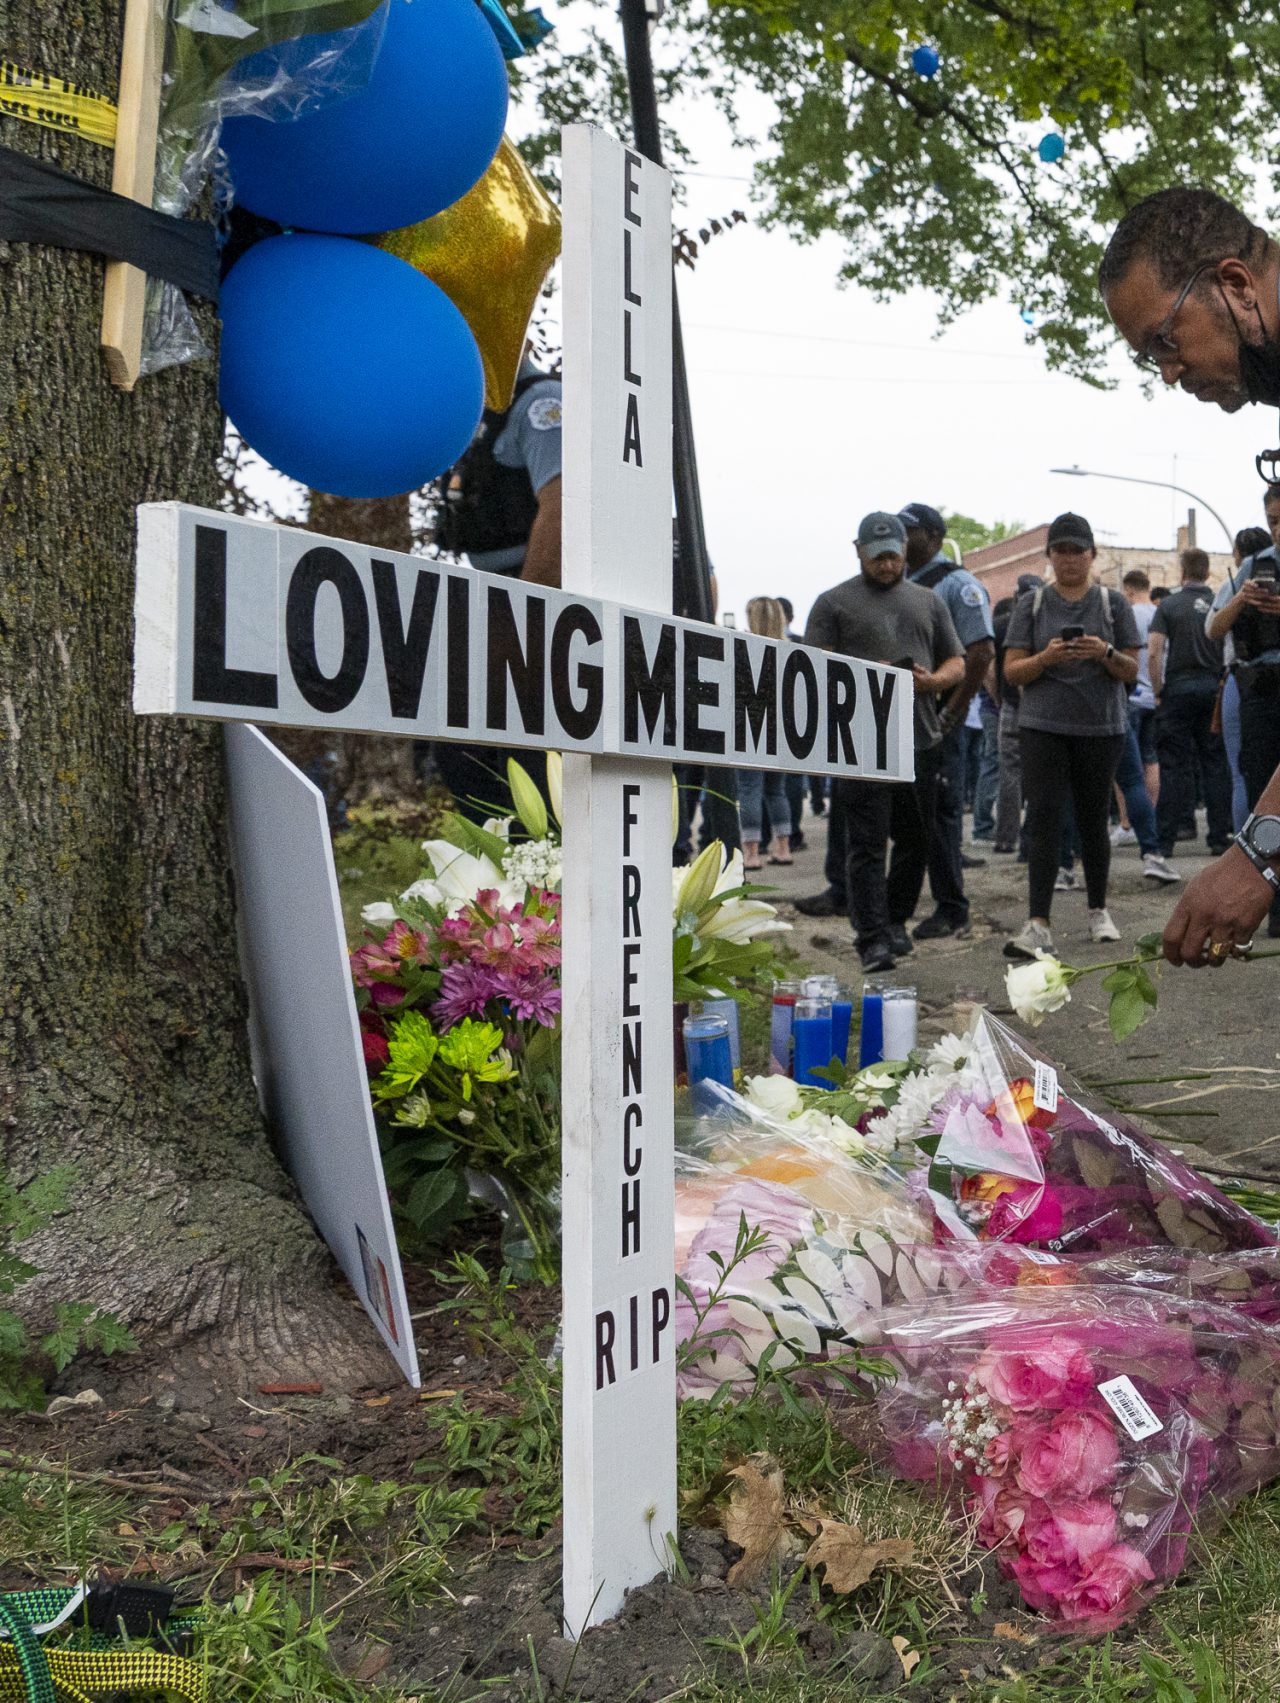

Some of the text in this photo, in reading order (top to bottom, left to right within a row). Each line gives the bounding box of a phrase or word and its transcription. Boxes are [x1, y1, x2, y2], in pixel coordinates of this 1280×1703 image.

[623, 148, 643, 468] ELLA
[192, 524, 898, 771] LOVING MEMORY
[622, 784, 643, 1258] FRENCH
[594, 1287, 670, 1390] RIP
